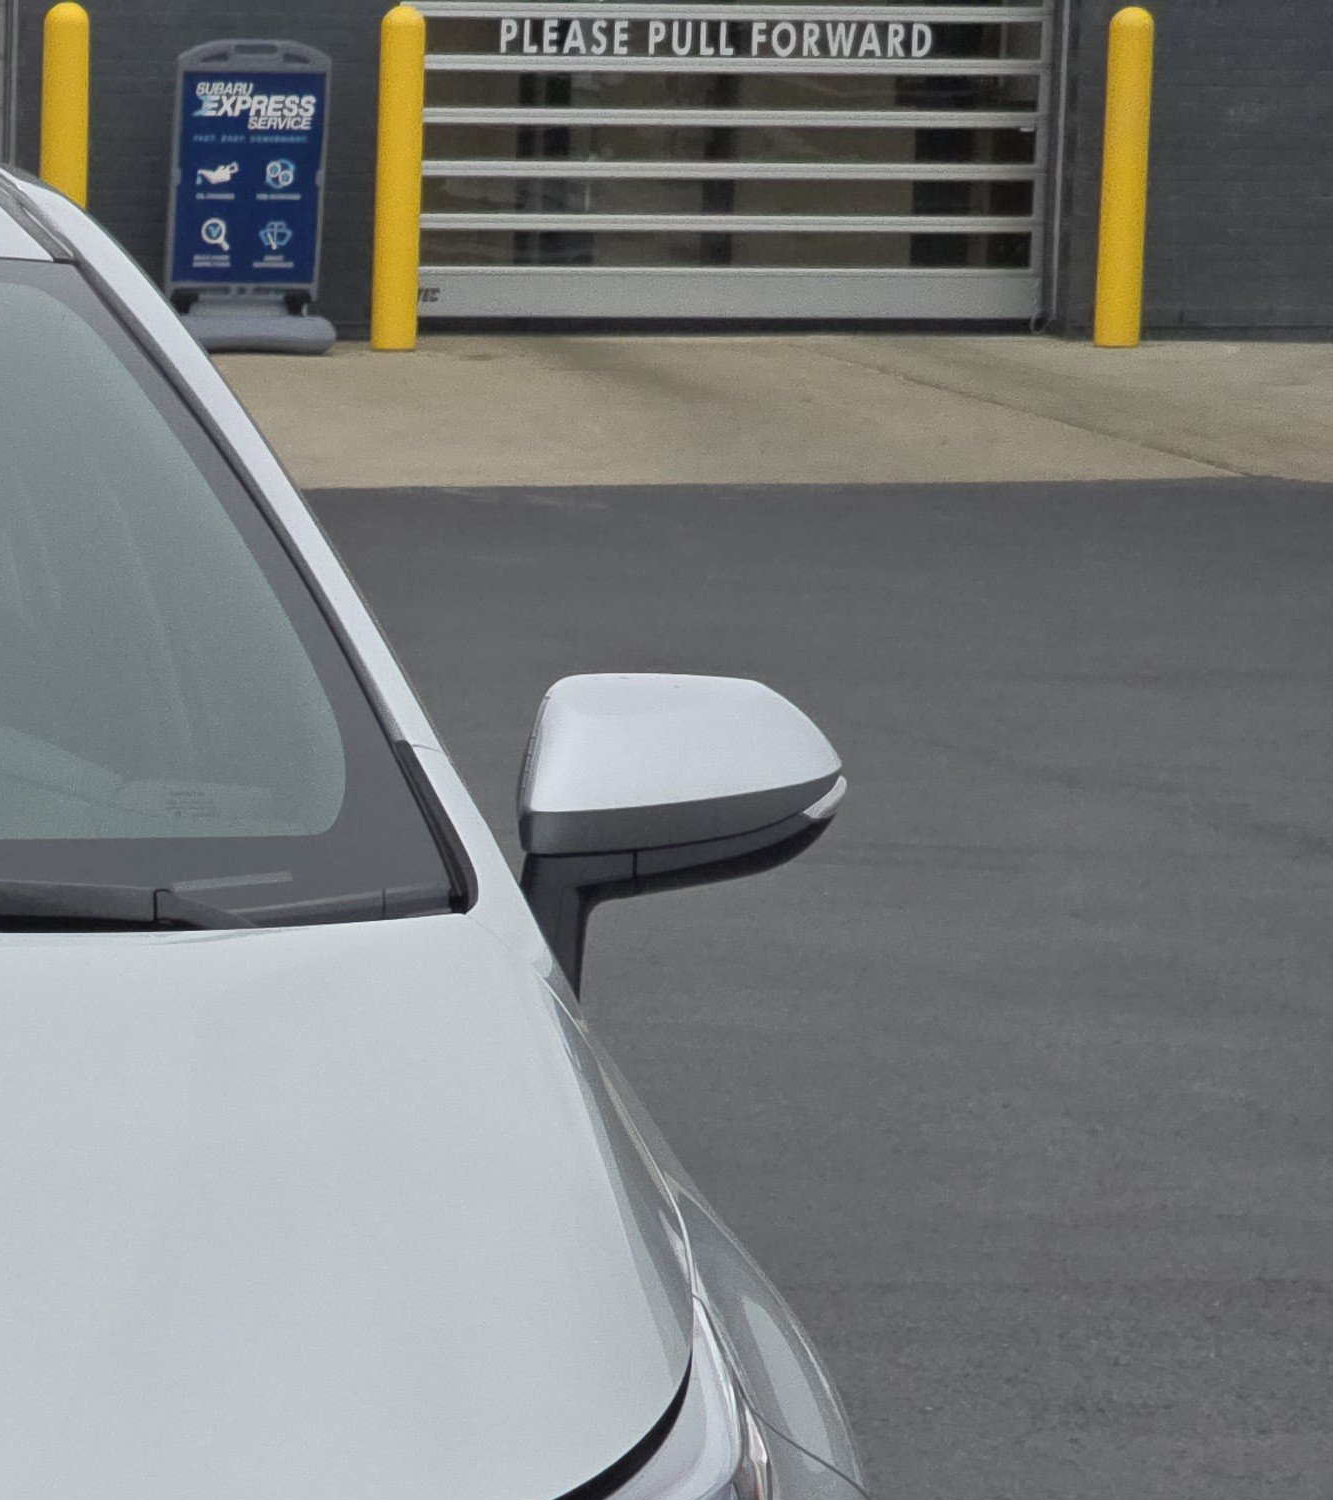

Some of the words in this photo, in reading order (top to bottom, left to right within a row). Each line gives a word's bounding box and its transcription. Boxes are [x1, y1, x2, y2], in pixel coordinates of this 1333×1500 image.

[500, 18, 629, 55] PLEASE
[648, 20, 734, 56] PULL
[751, 21, 932, 58] FORWARD
[195, 82, 254, 96] SUBARU
[193, 95, 317, 117] EXPRESS
[247, 117, 312, 130] SERVICE
